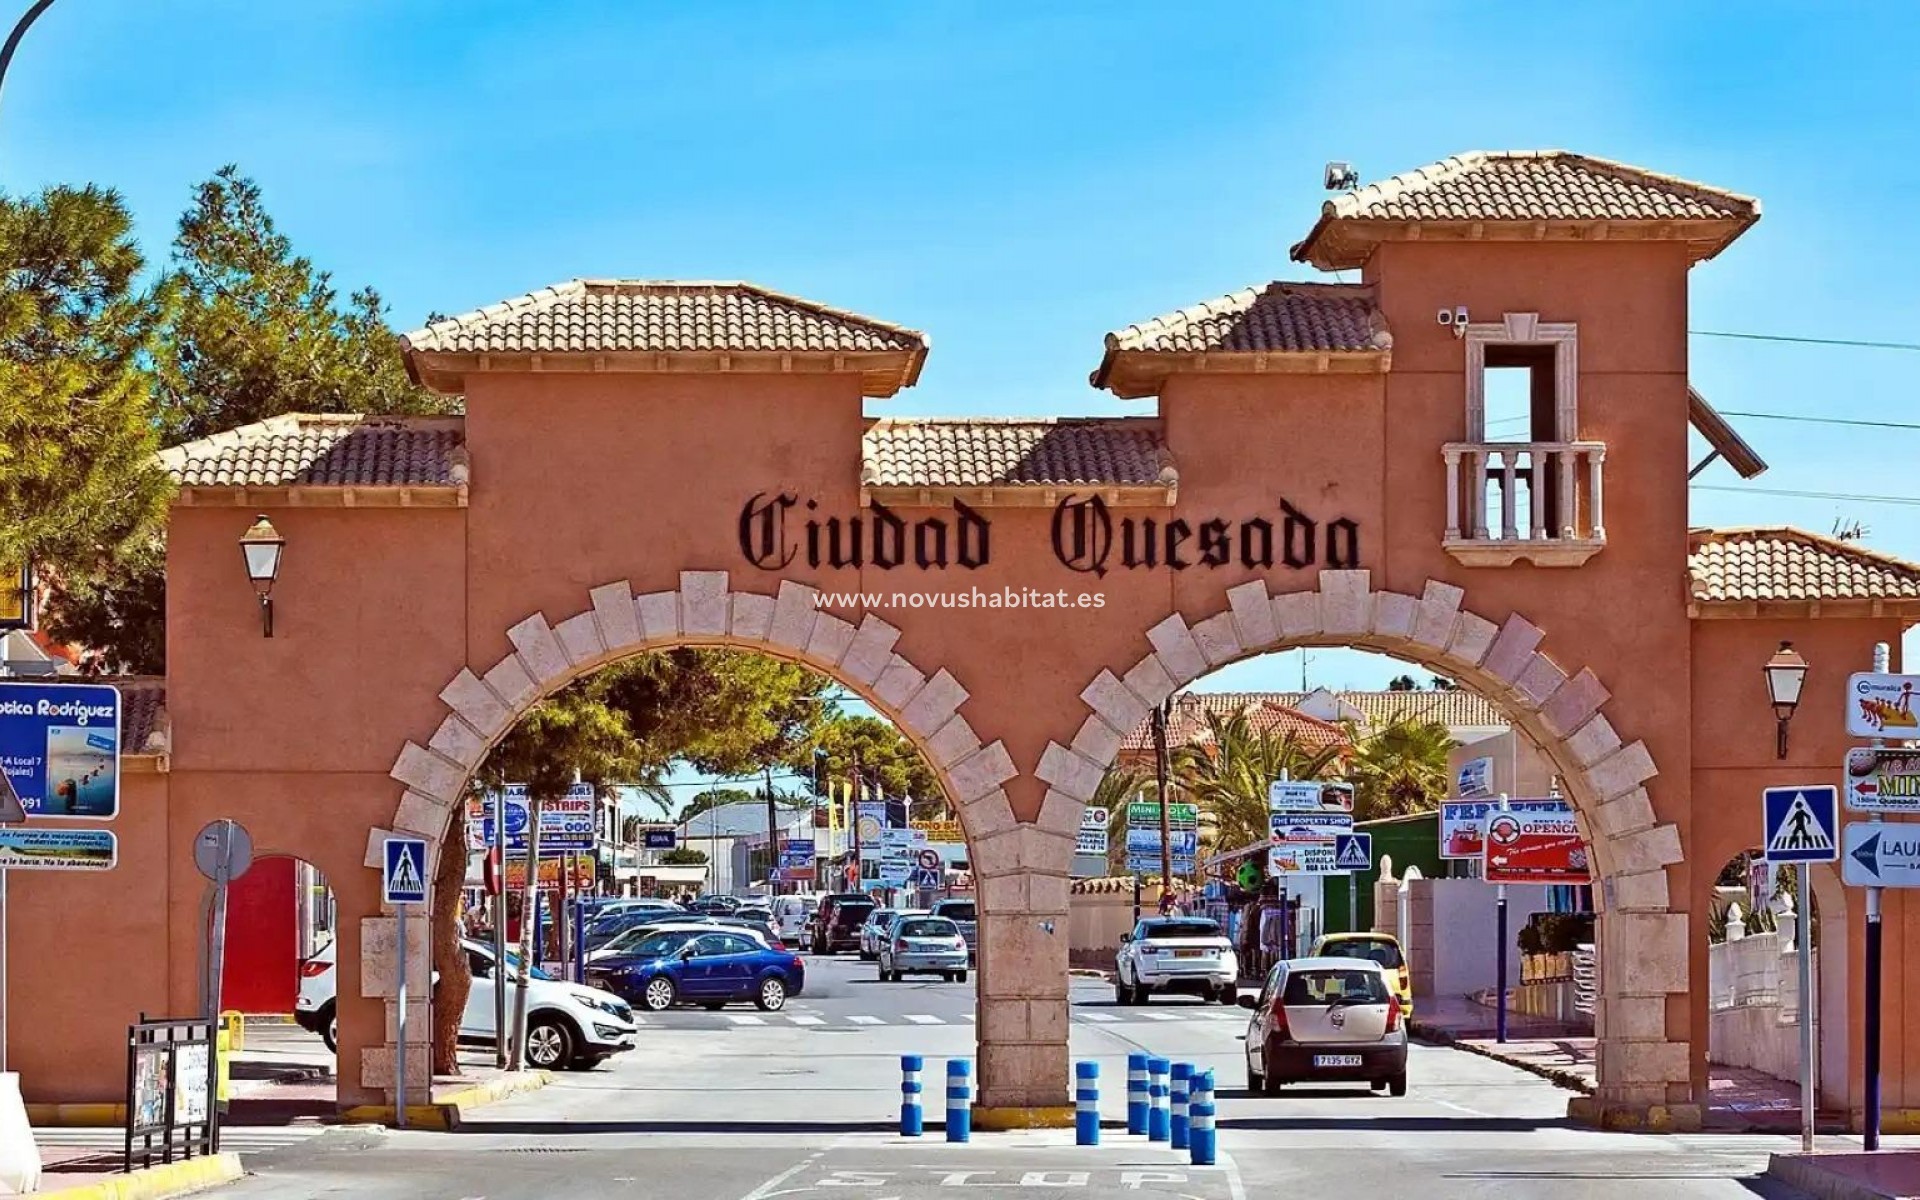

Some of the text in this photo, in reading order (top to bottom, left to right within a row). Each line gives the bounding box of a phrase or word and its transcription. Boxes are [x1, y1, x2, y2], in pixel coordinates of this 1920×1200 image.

[738, 493, 1361, 579] Ciudad Quesada
[38, 700, 115, 726] Rodríguez
[14, 756, 34, 766] Local
[1883, 840, 1920, 856] LAU
[815, 1171, 1188, 1189] STOP
